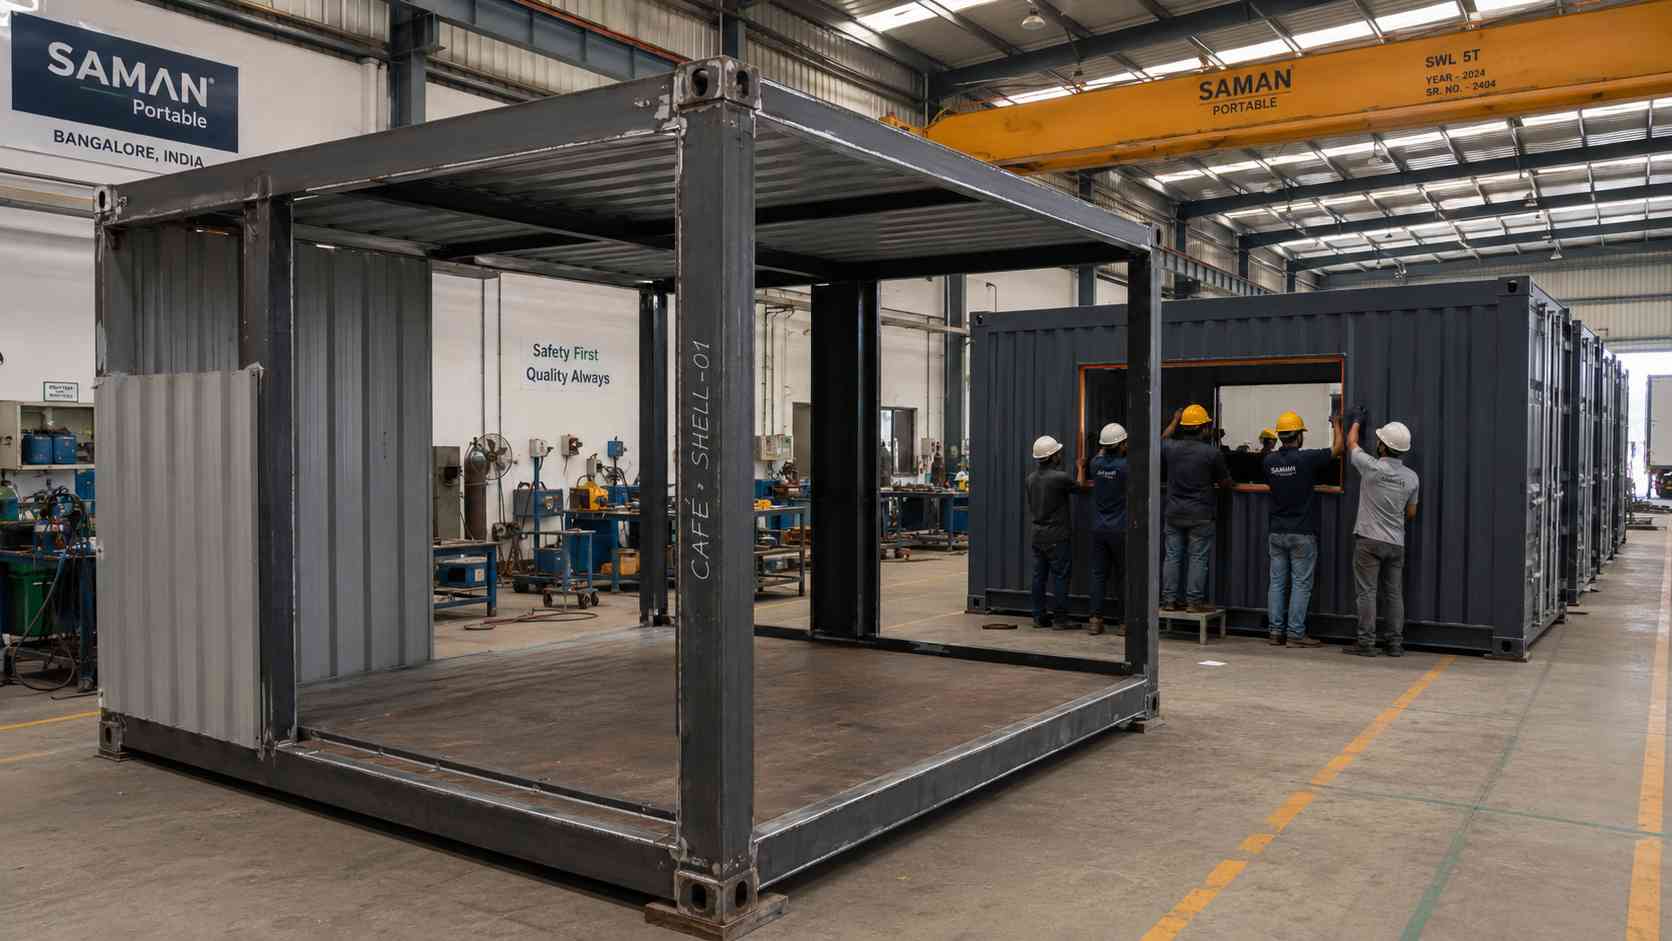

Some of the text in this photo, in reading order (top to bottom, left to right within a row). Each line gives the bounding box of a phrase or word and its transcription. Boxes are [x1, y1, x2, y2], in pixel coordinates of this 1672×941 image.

[1425, 48, 1481, 69] SWL 5T
[48, 41, 208, 108] SAMAN
[1199, 68, 1292, 101] SAMAN
[1425, 72, 1453, 86] YEAR
[1463, 69, 1486, 80] 2024
[1425, 86, 1442, 97] SR.
[1445, 83, 1463, 94] NO.
[1472, 80, 1496, 91] 2404
[133, 98, 208, 129] Portable
[1212, 97, 1278, 116] PORTABLE
[53, 129, 205, 168] BANGALORE, INDIA
[533, 343, 600, 362] Safety First
[526, 366, 610, 388] Quality Always
[684, 498, 711, 580] CAFÉ
